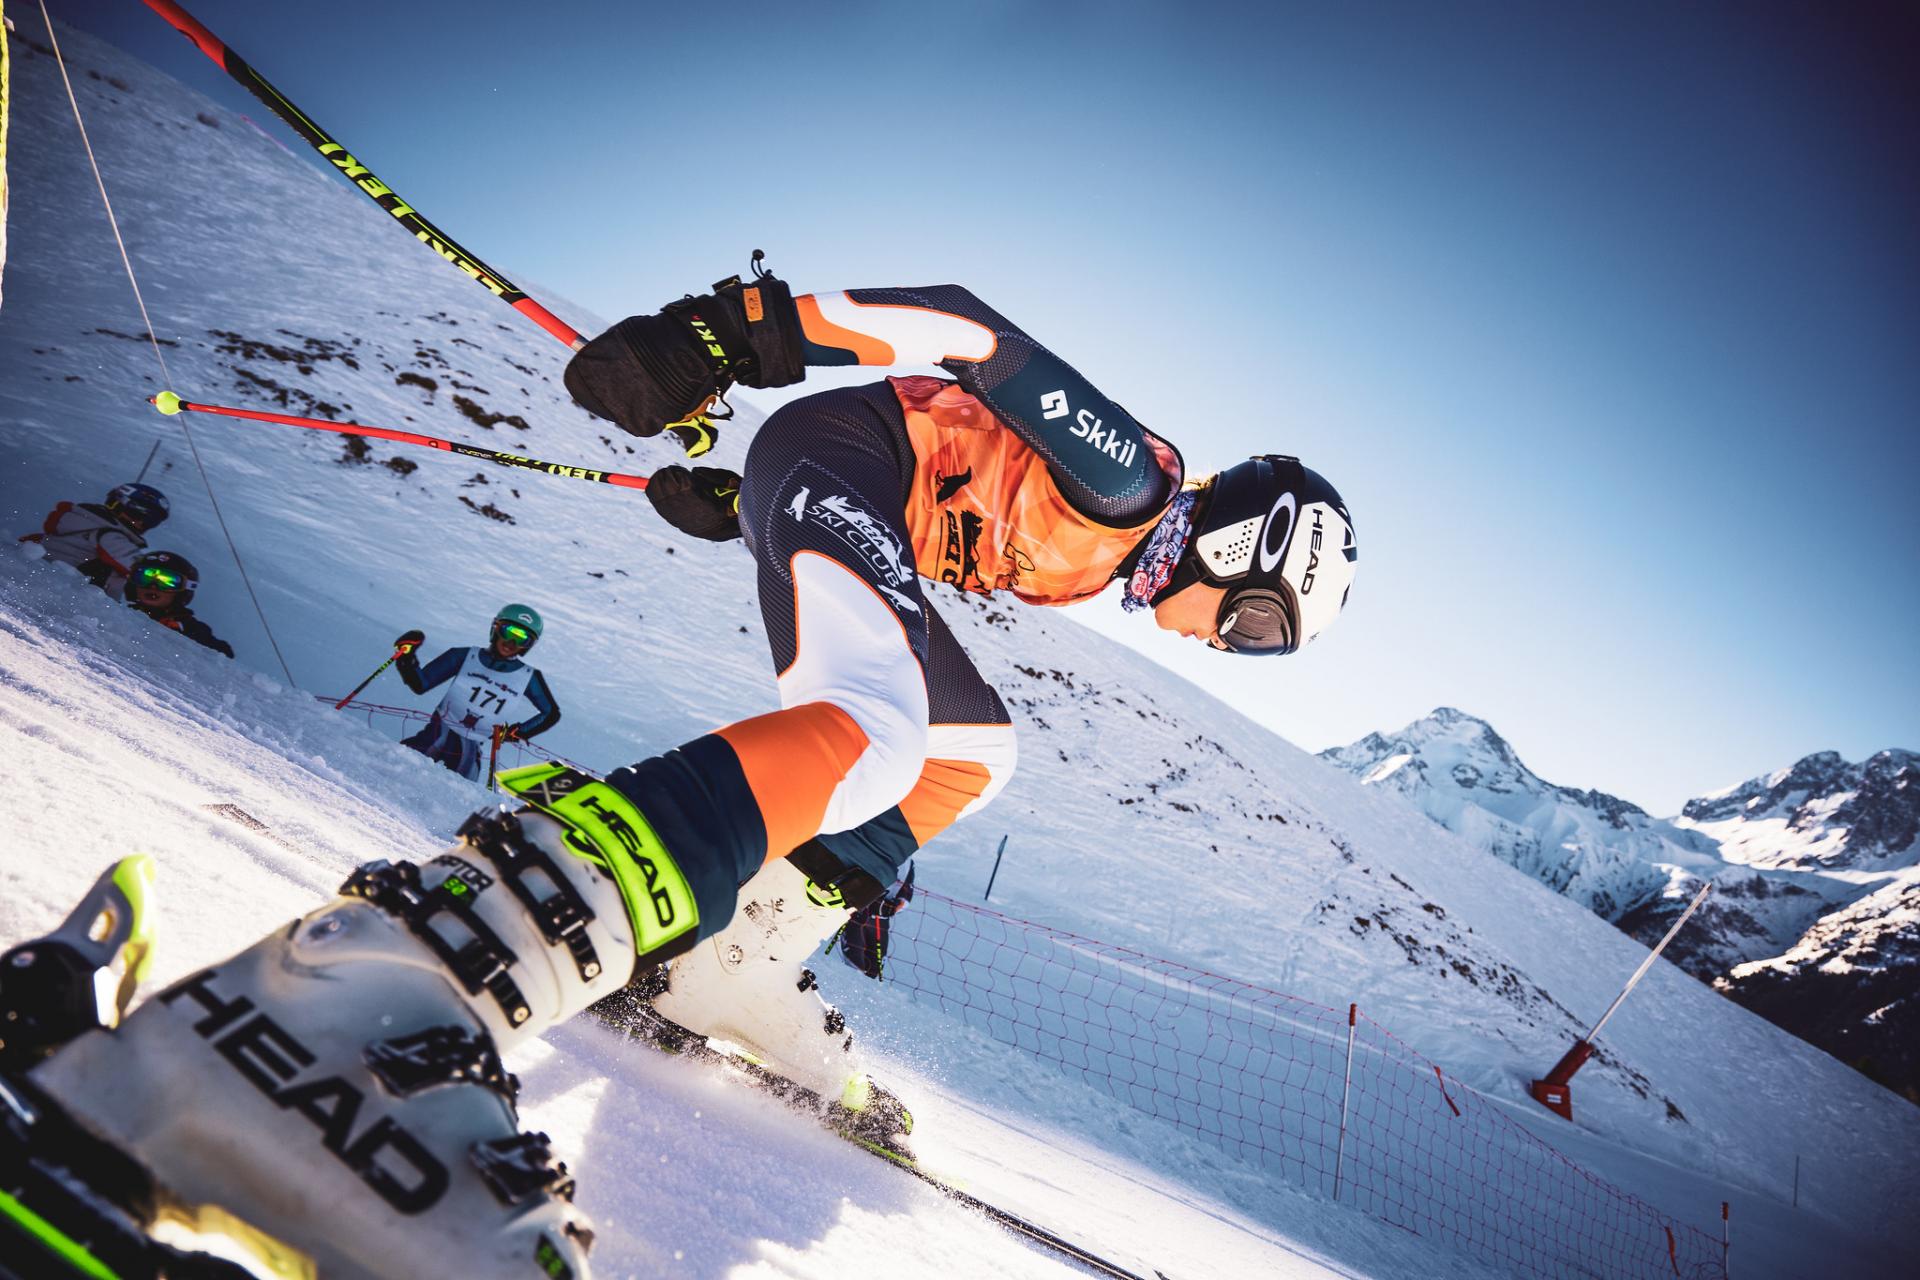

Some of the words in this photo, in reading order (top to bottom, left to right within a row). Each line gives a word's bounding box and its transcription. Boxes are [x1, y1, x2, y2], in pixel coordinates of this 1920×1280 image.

[318, 143, 416, 218] LEKI
[690, 321, 728, 368] EKI
[547, 464, 603, 482] LEKI
[1068, 408, 1137, 468] Skkil
[805, 504, 845, 528] SKI
[846, 530, 900, 588] CLUB
[1300, 508, 1323, 595] HEAD
[469, 686, 506, 715] 171
[579, 795, 675, 928] HEAD
[160, 969, 450, 1216] HEAD
